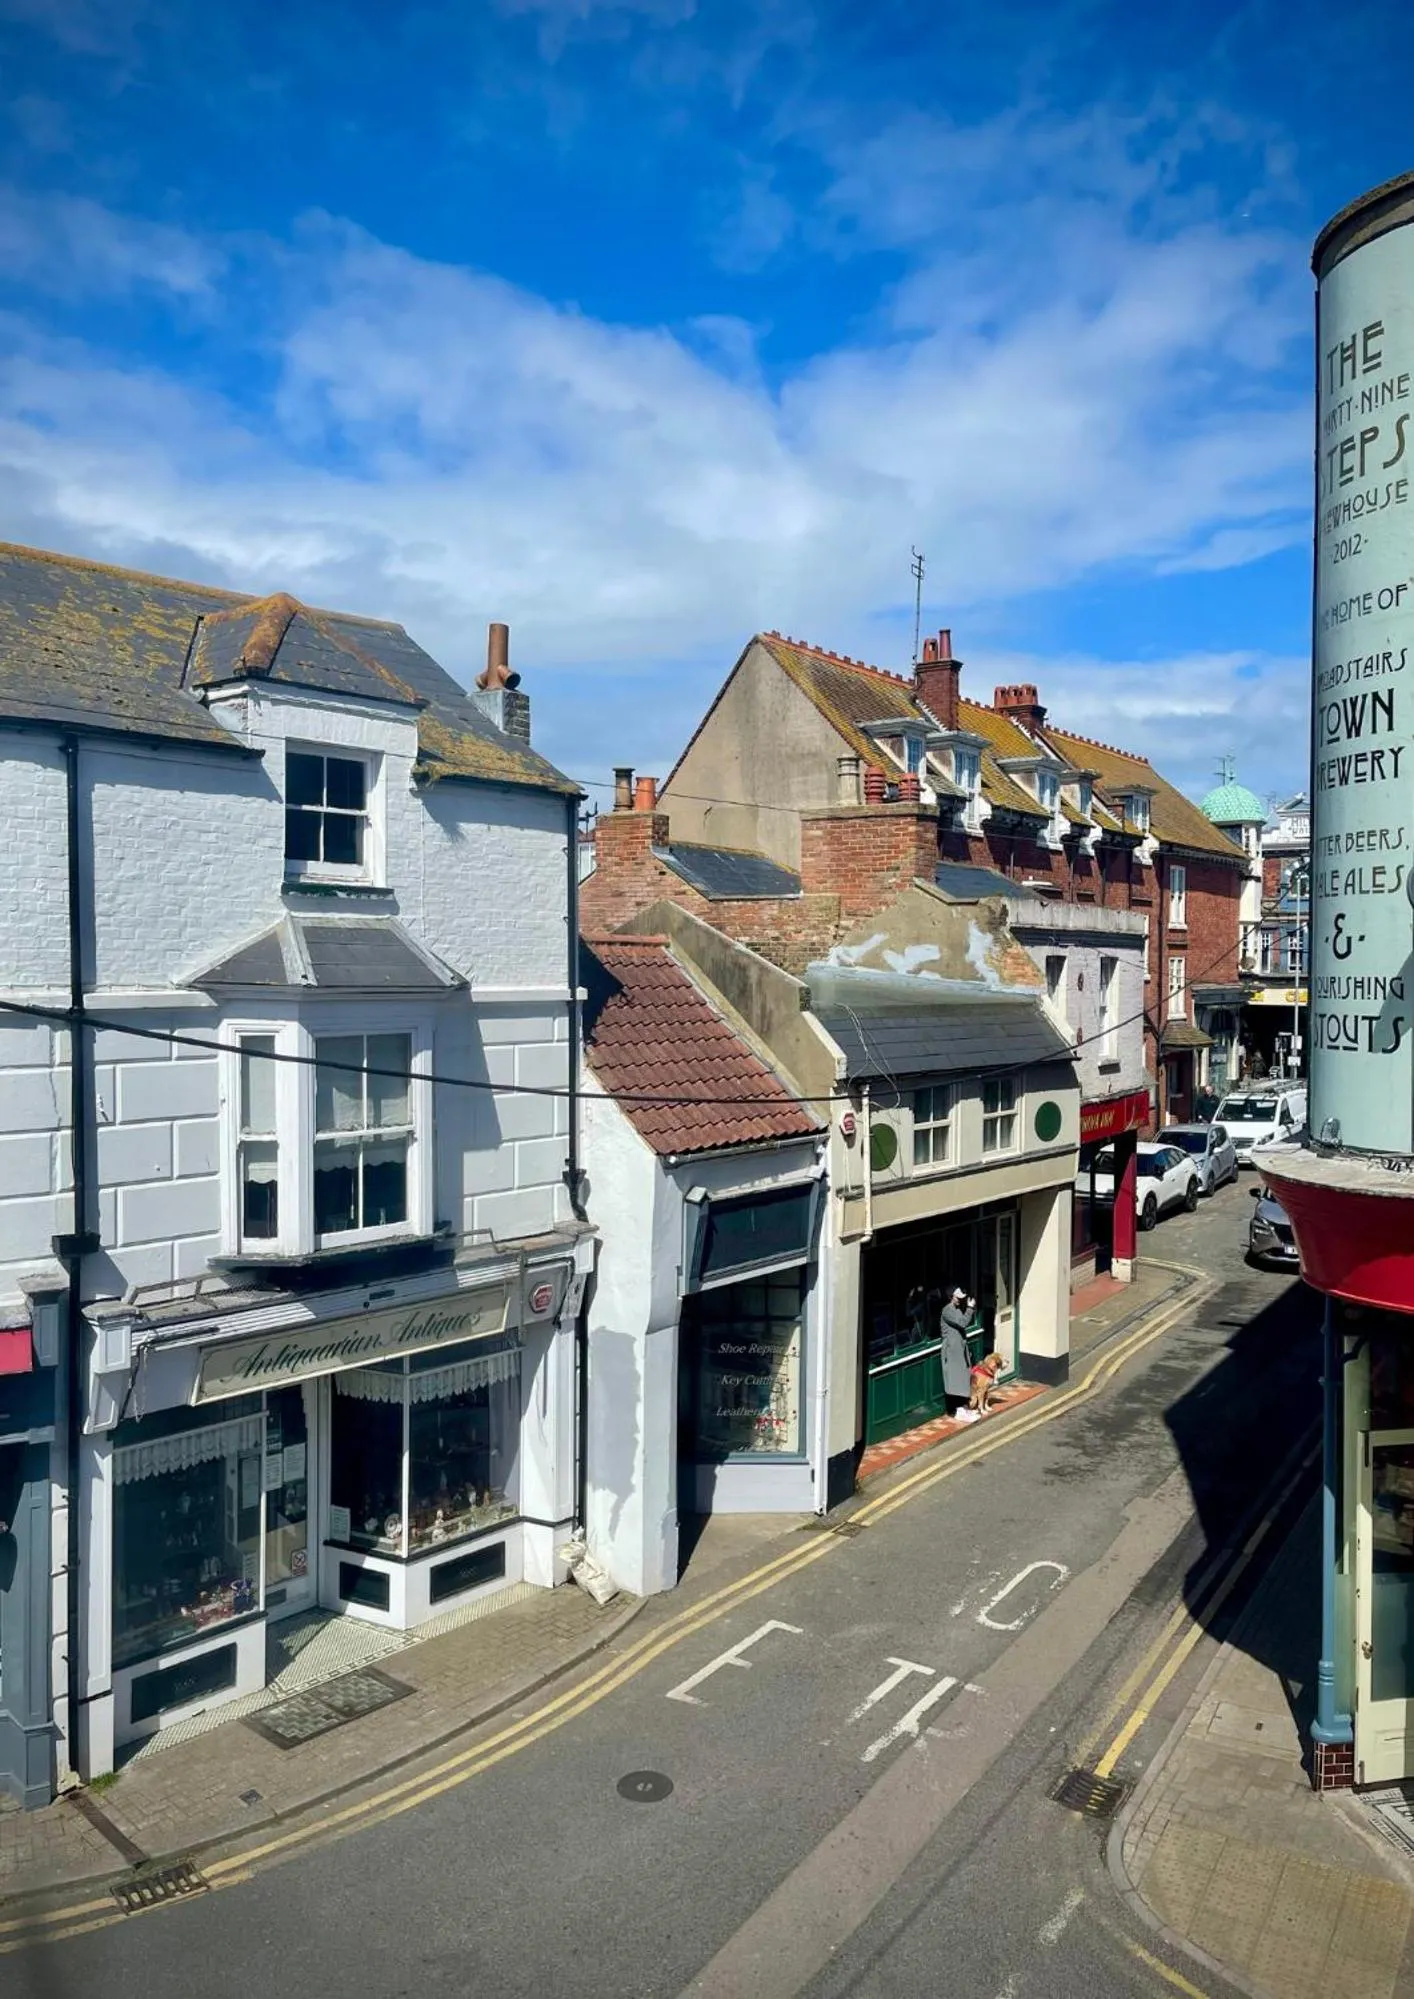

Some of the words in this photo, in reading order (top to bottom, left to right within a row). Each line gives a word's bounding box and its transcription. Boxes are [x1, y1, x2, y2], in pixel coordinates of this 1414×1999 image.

[1327, 320, 1385, 395] THE
[1331, 591, 1373, 629] HOME
[1377, 583, 1408, 610] OF
[1319, 687, 1395, 748] TOWN
[1317, 746, 1405, 791] REWERY
[1344, 864, 1405, 896] ALES
[232, 1330, 381, 1379] Antiquarian
[388, 1306, 481, 1347] Antiques
[718, 1342, 746, 1354] Shoe
[721, 1374, 742, 1387] Key
